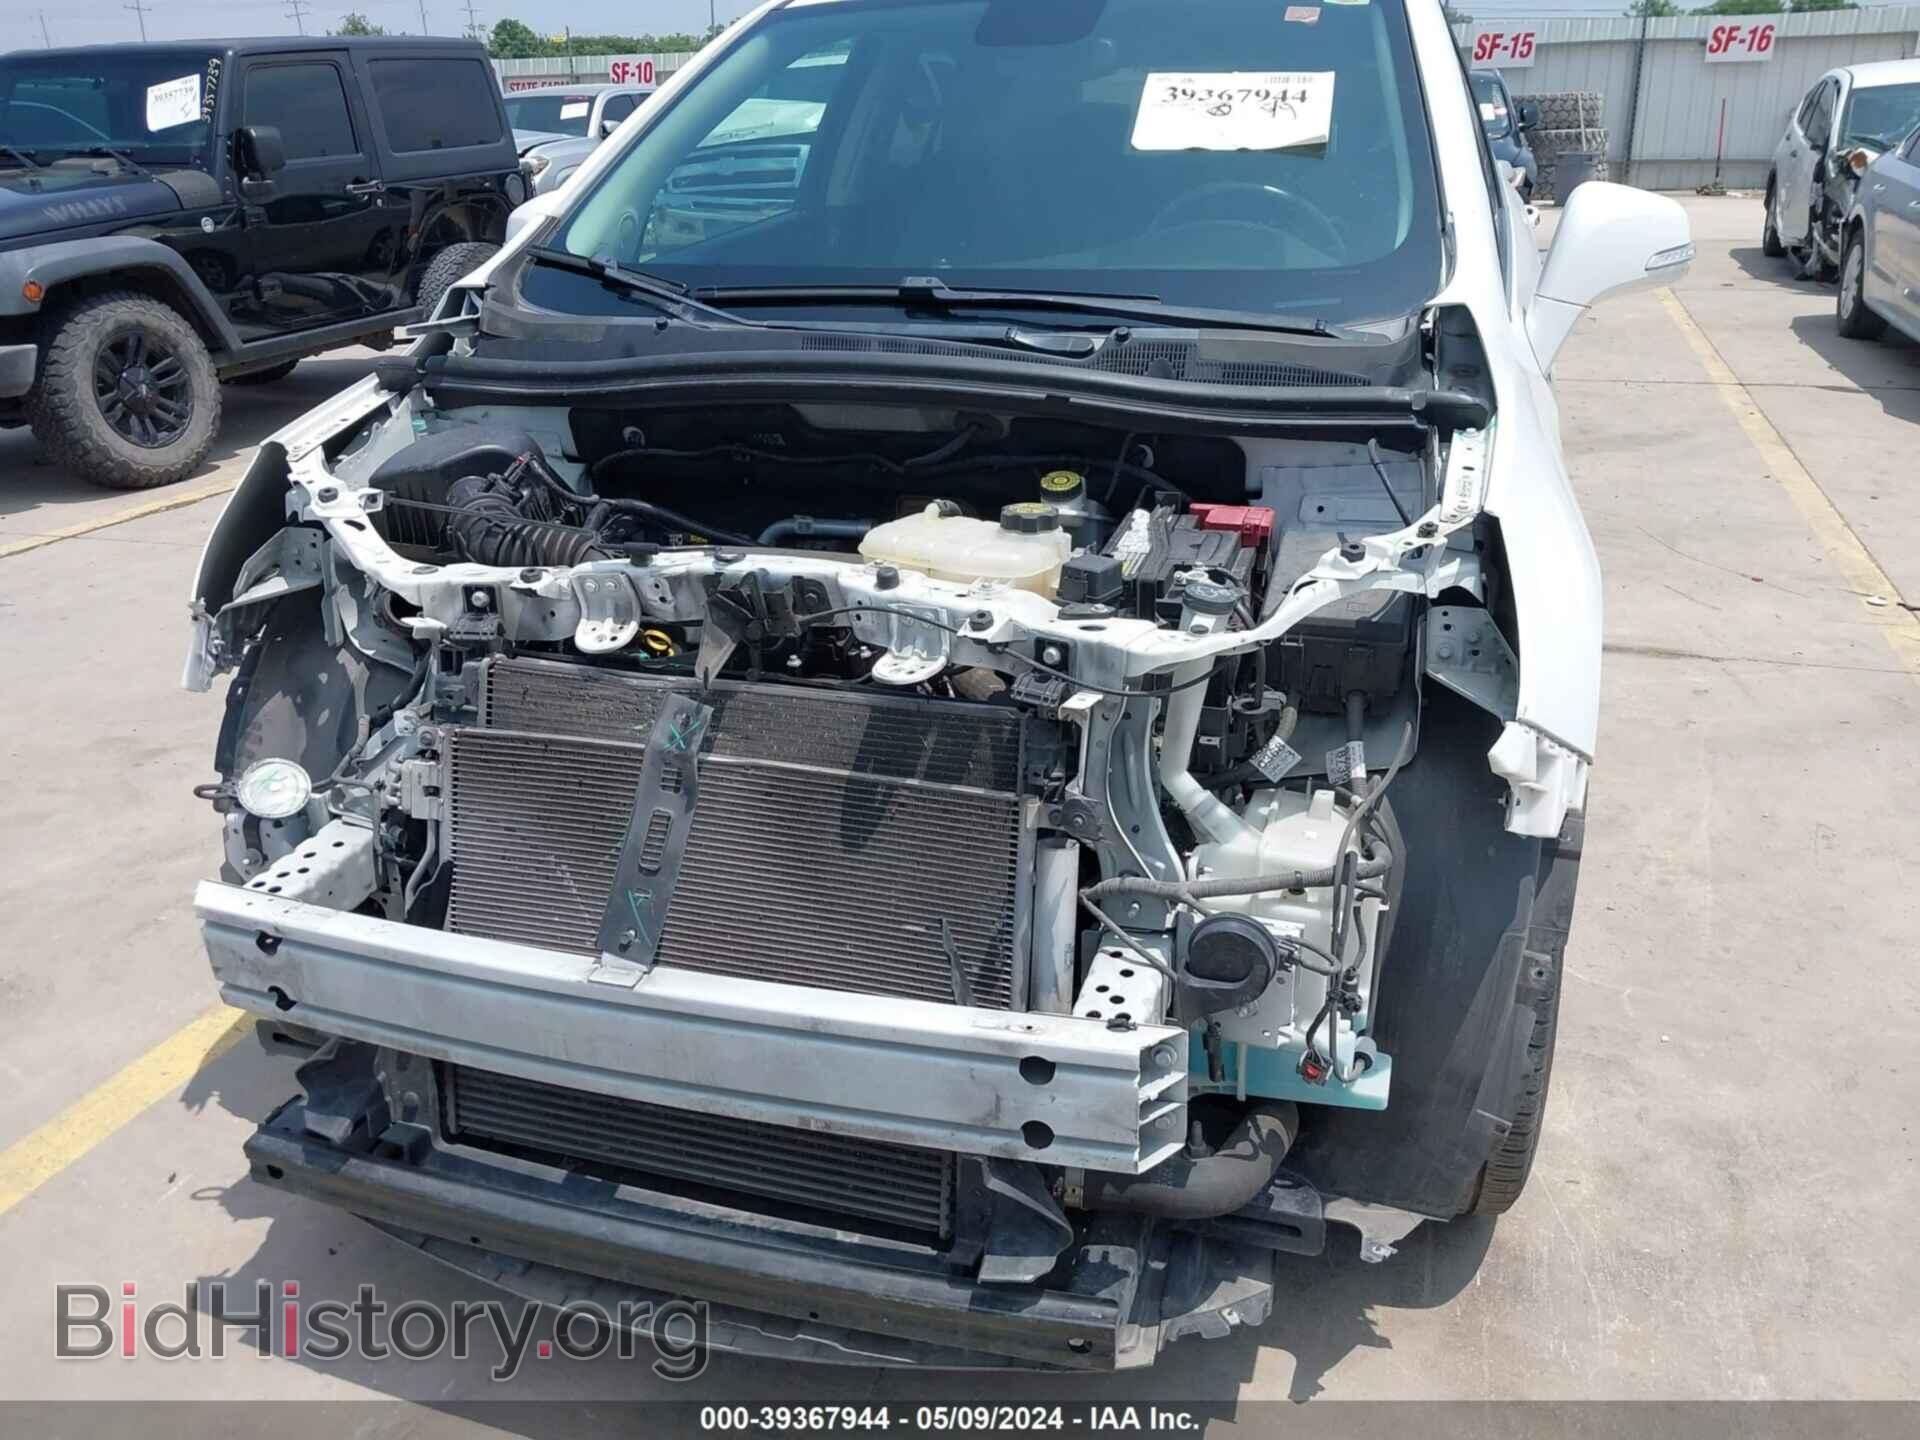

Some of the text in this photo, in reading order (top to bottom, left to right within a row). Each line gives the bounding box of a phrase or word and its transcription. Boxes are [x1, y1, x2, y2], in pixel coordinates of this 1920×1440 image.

[1474, 32, 1536, 60] SF-15
[1708, 24, 1775, 53] SF-16
[611, 61, 653, 84] SF-10
[1162, 86, 1307, 103] 39367944
